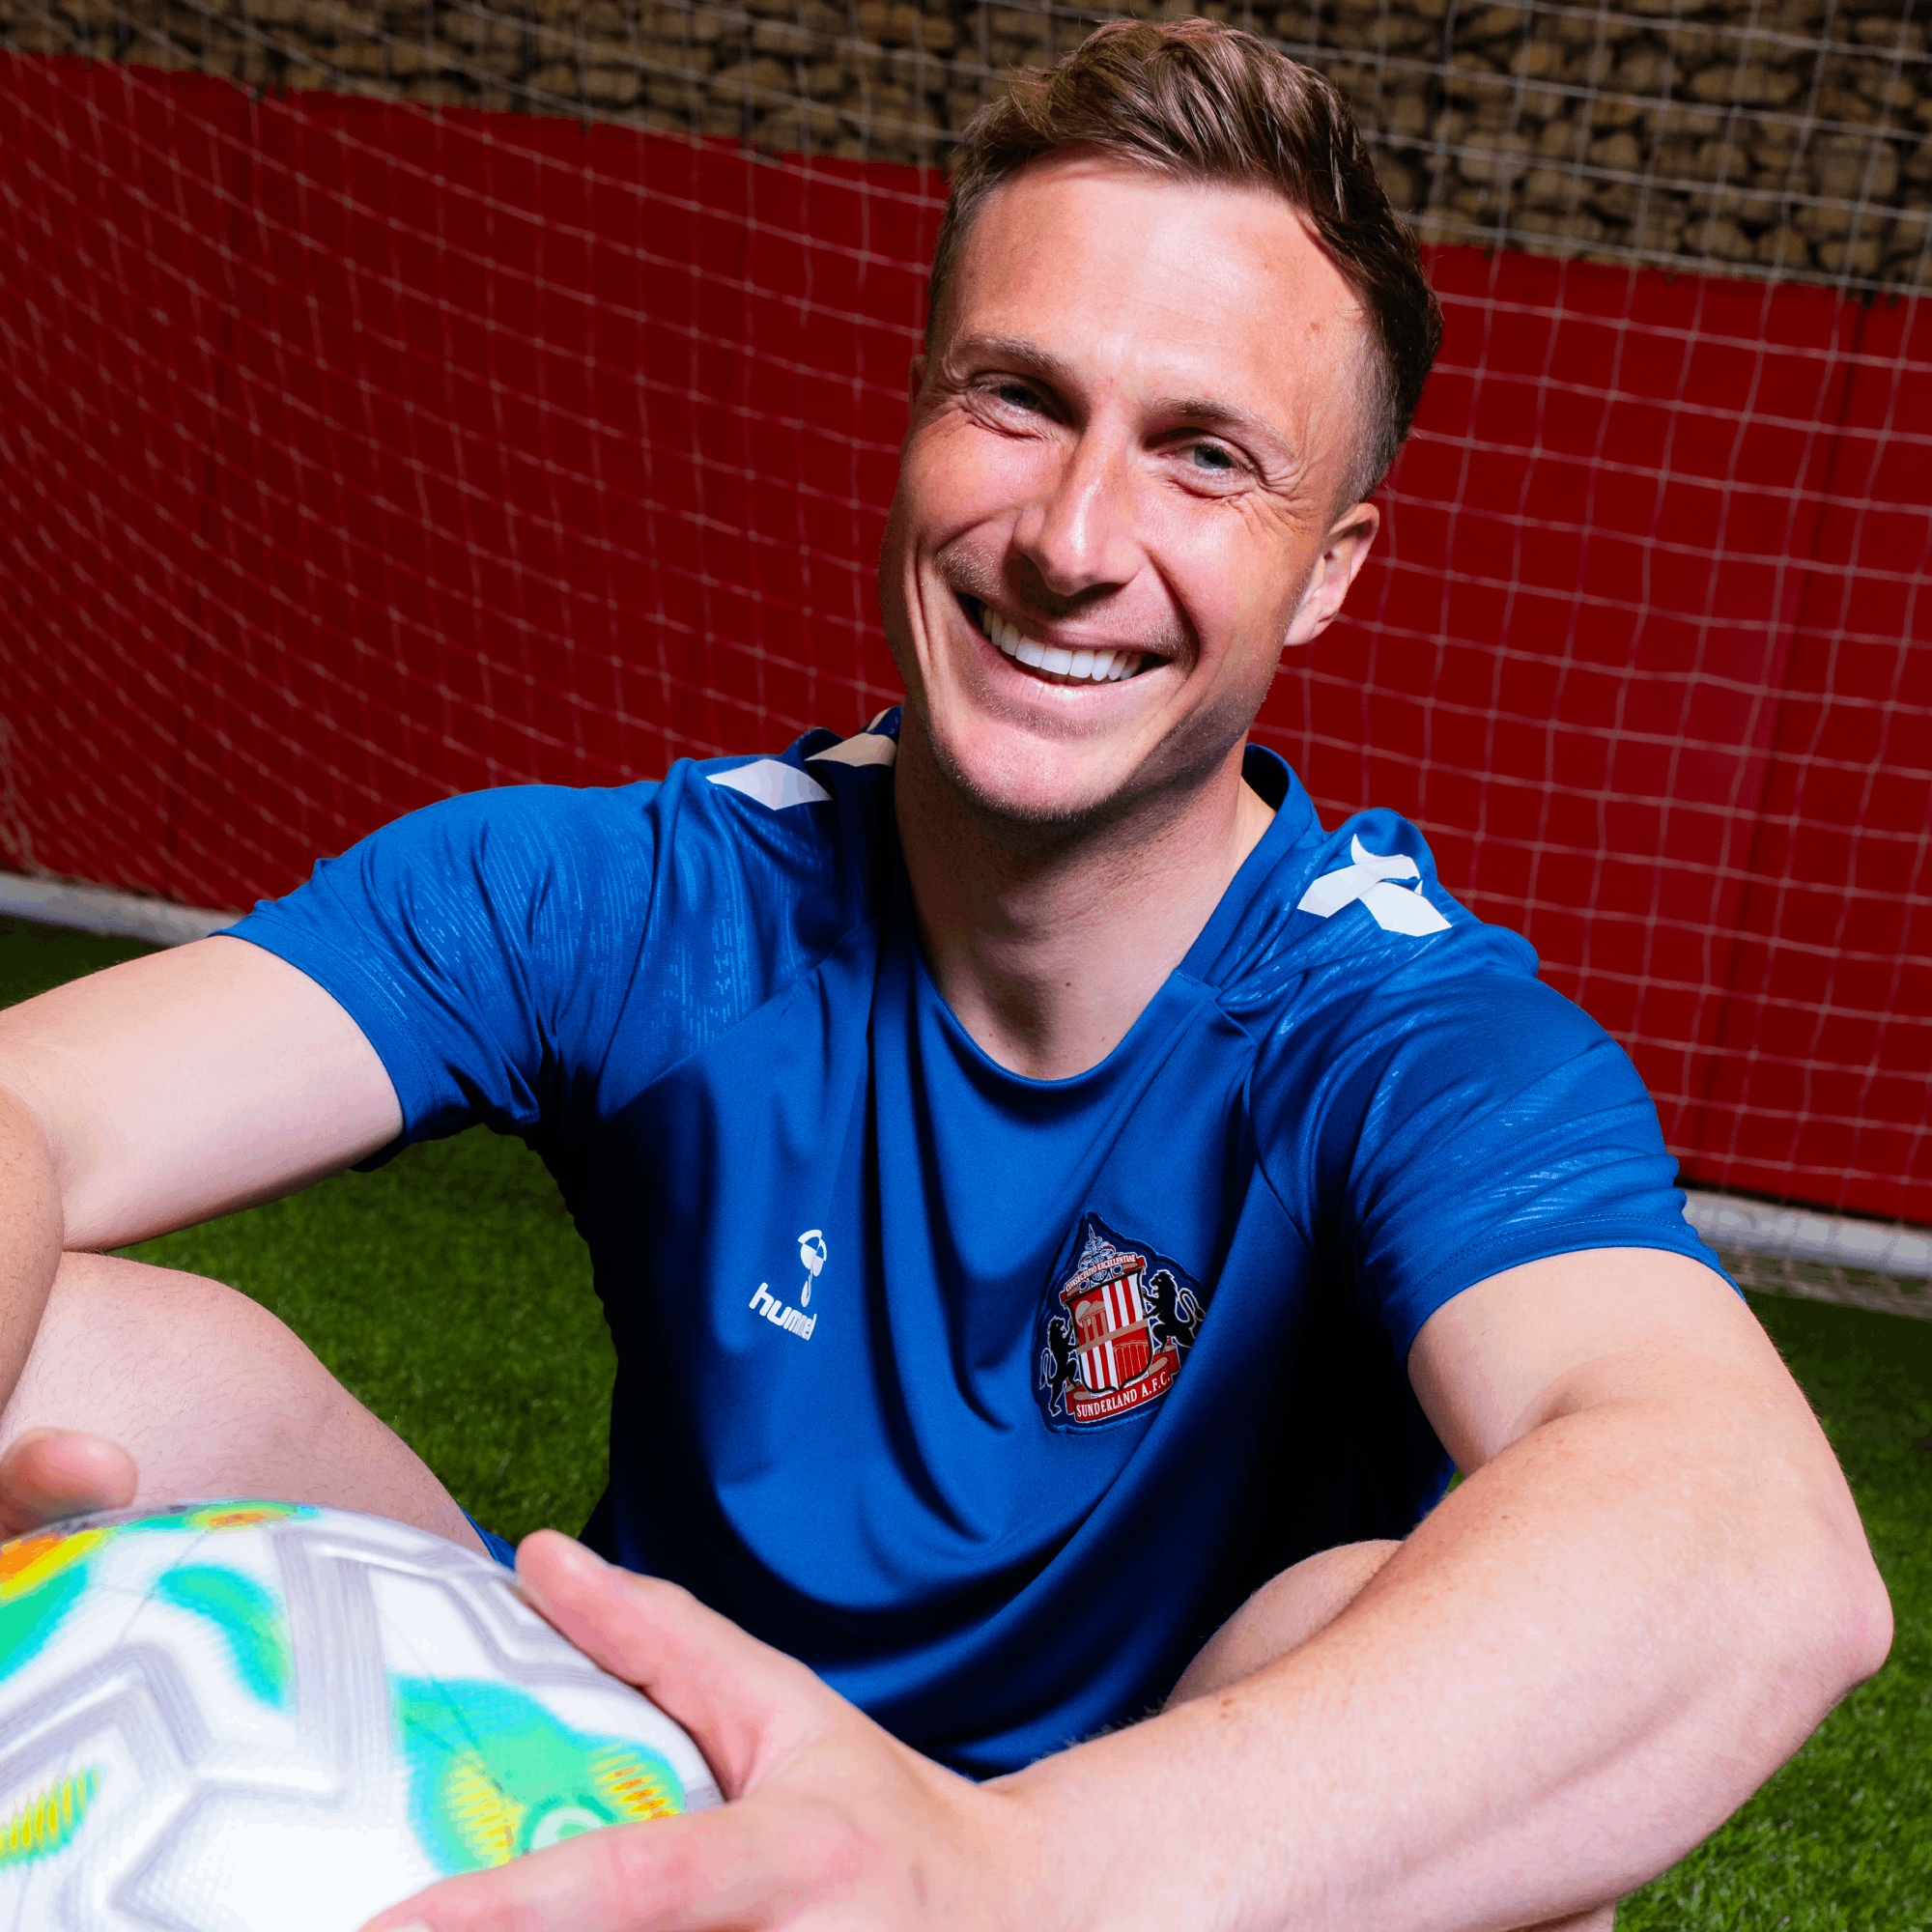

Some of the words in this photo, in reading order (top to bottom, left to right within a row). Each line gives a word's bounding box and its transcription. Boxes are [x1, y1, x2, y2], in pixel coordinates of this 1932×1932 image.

[749, 1282, 817, 1341] hummel
[1076, 1389, 1138, 1418] SUNDERLAND
[1141, 1371, 1171, 1398] A.F.C.
